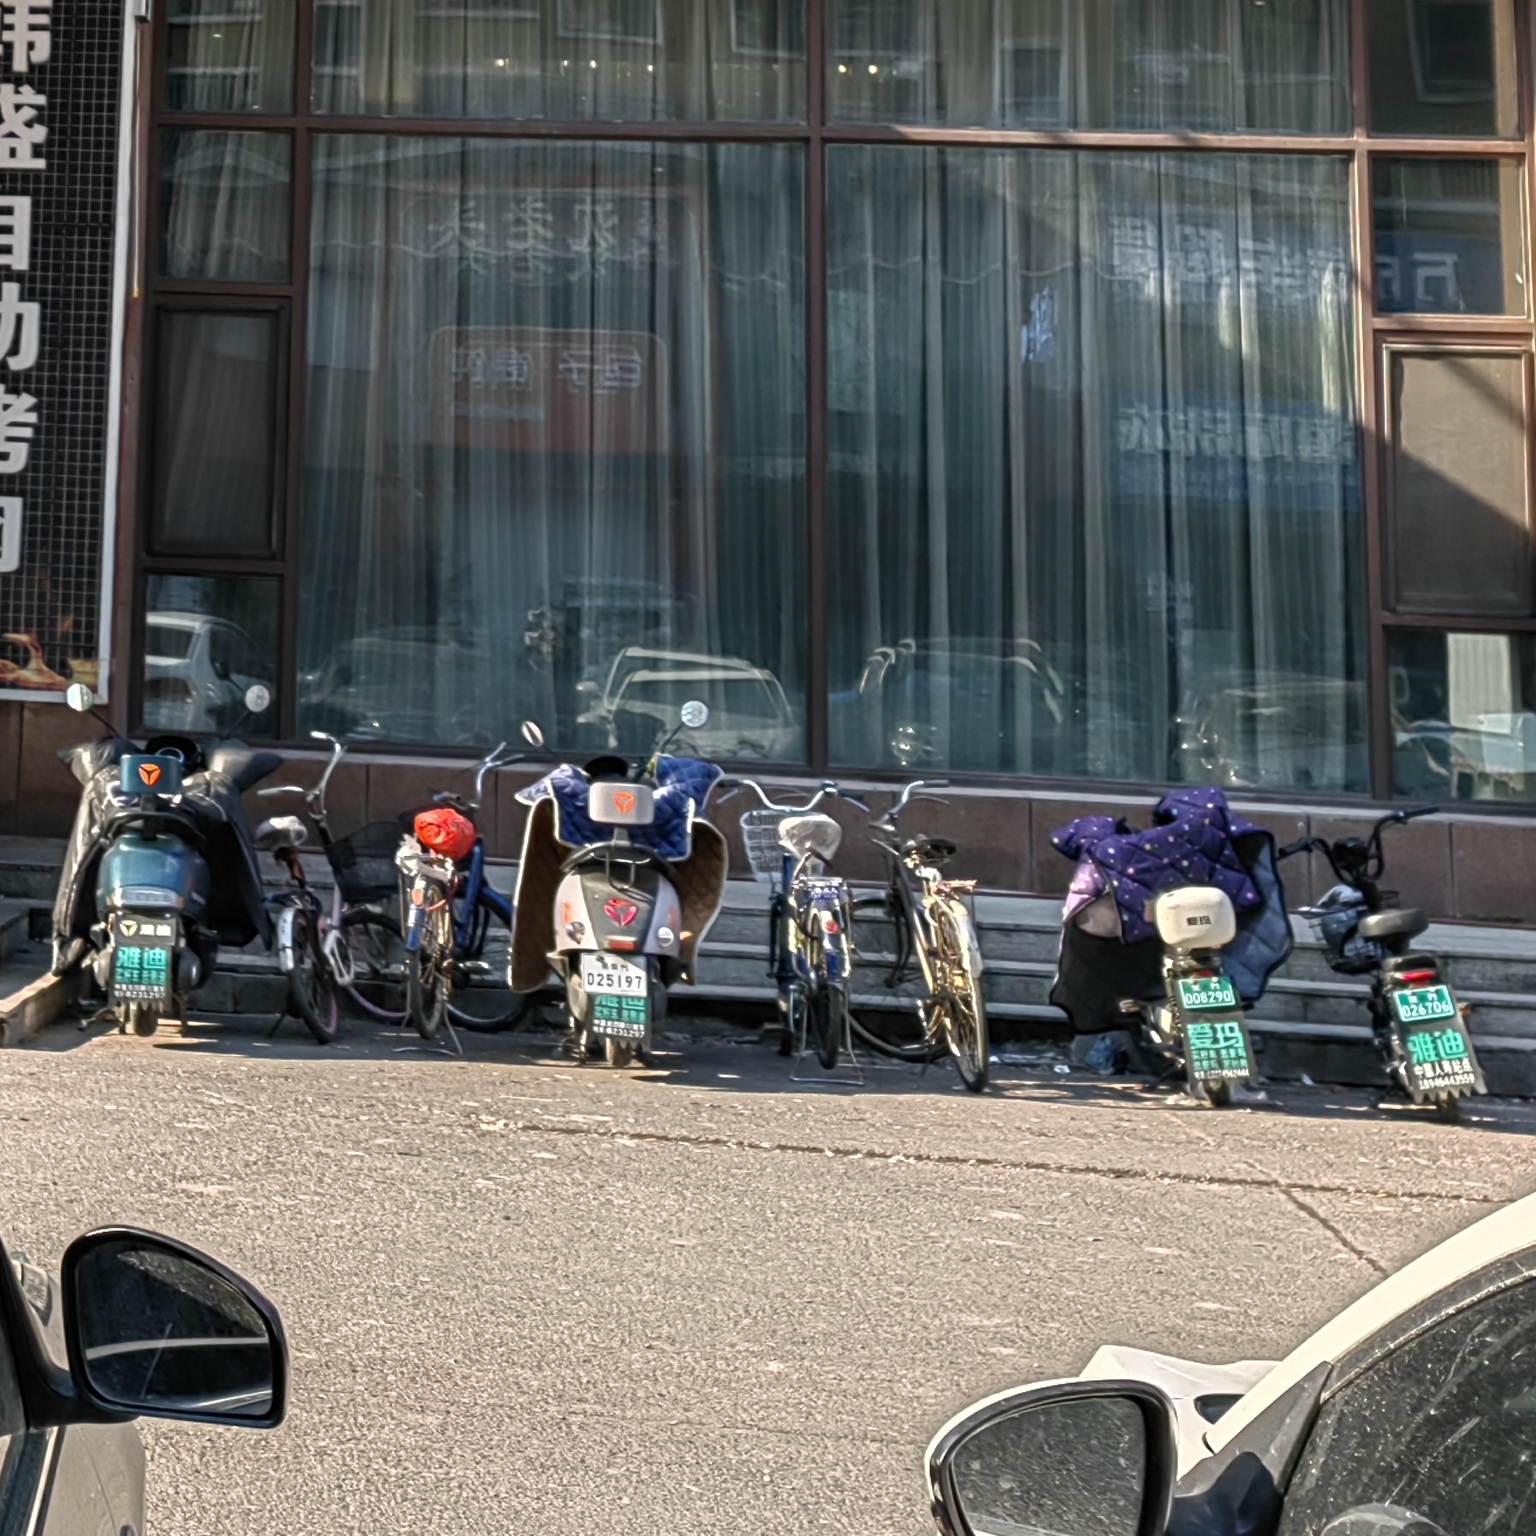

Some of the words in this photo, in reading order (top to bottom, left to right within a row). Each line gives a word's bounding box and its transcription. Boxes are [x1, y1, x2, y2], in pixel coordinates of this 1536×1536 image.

[116, 946, 167, 969] 雅迪
[1186, 1022, 1244, 1050] 爱玛
[1407, 1028, 1469, 1064] 雅迪
